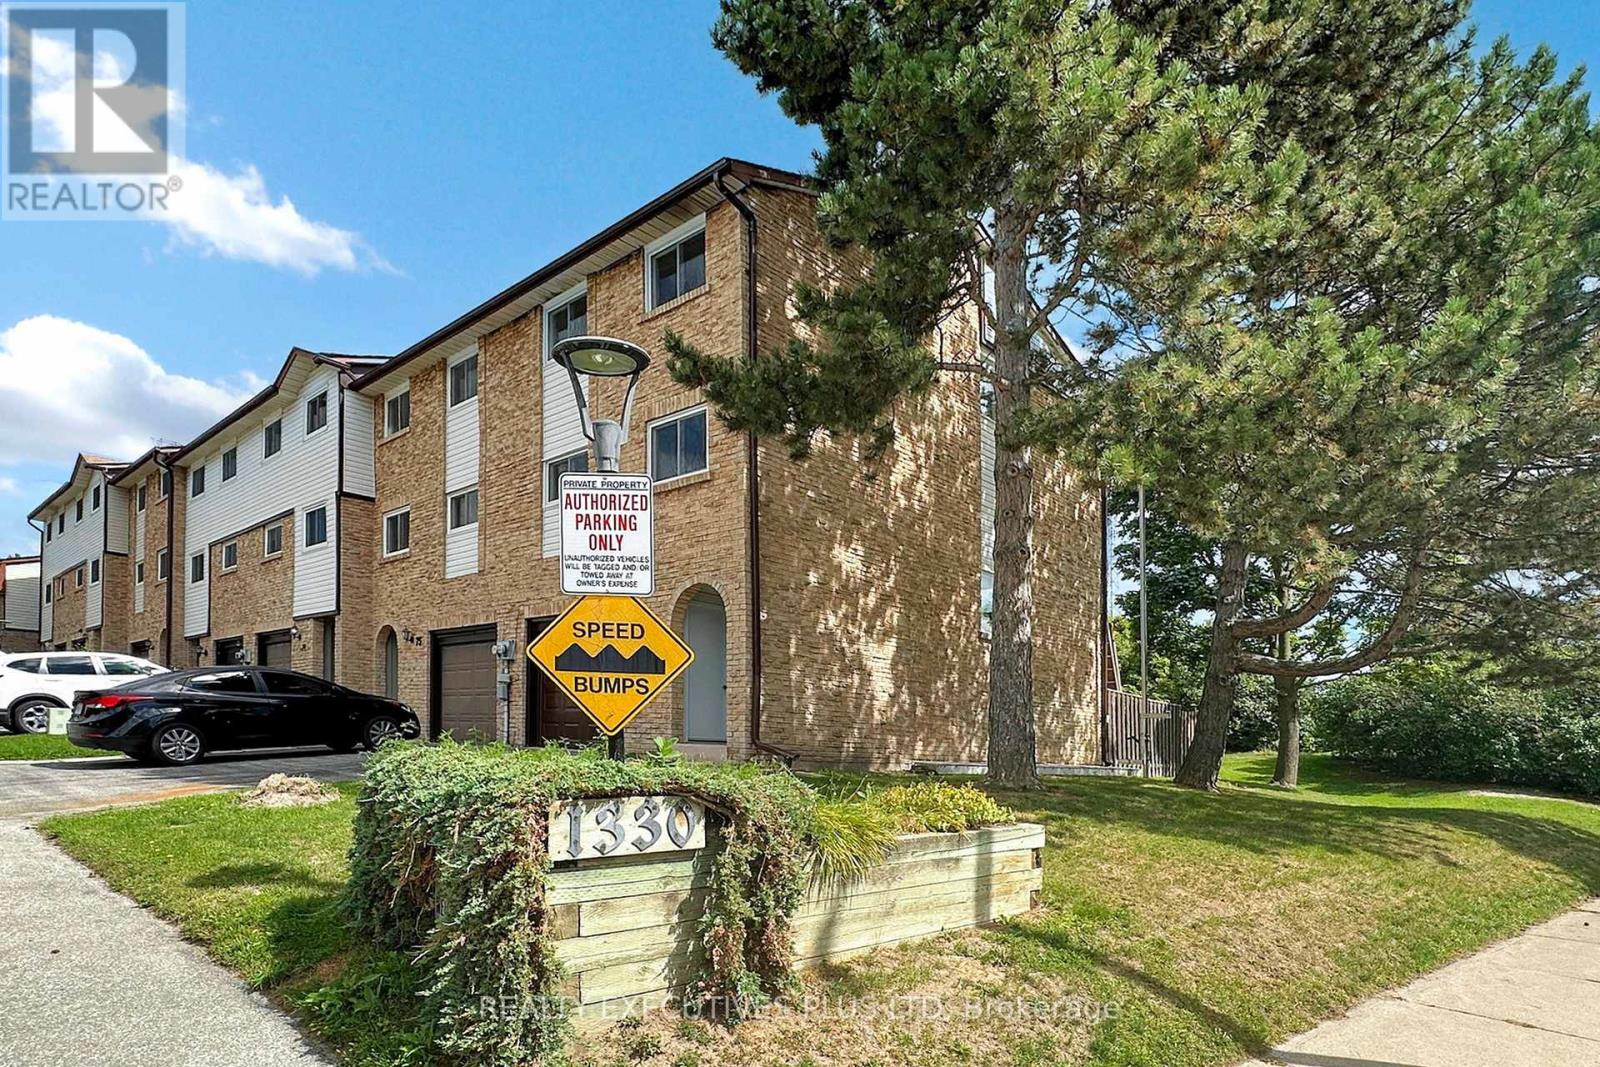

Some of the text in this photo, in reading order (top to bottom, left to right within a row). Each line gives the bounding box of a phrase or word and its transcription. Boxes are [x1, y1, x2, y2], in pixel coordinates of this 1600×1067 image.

[563, 480, 648, 490] PRIVATE PROPERTY
[564, 493, 648, 511] AUTHORIZED
[575, 514, 638, 531] PARKING
[589, 534, 624, 551] ONLY
[564, 554, 650, 563] UNAUTHORIZED VEHICLES
[580, 571, 604, 579] TOWED
[608, 580, 638, 588] EXPENSE
[572, 621, 645, 639] SPEED
[574, 676, 650, 695] BUMPS
[566, 799, 696, 858] 1330
